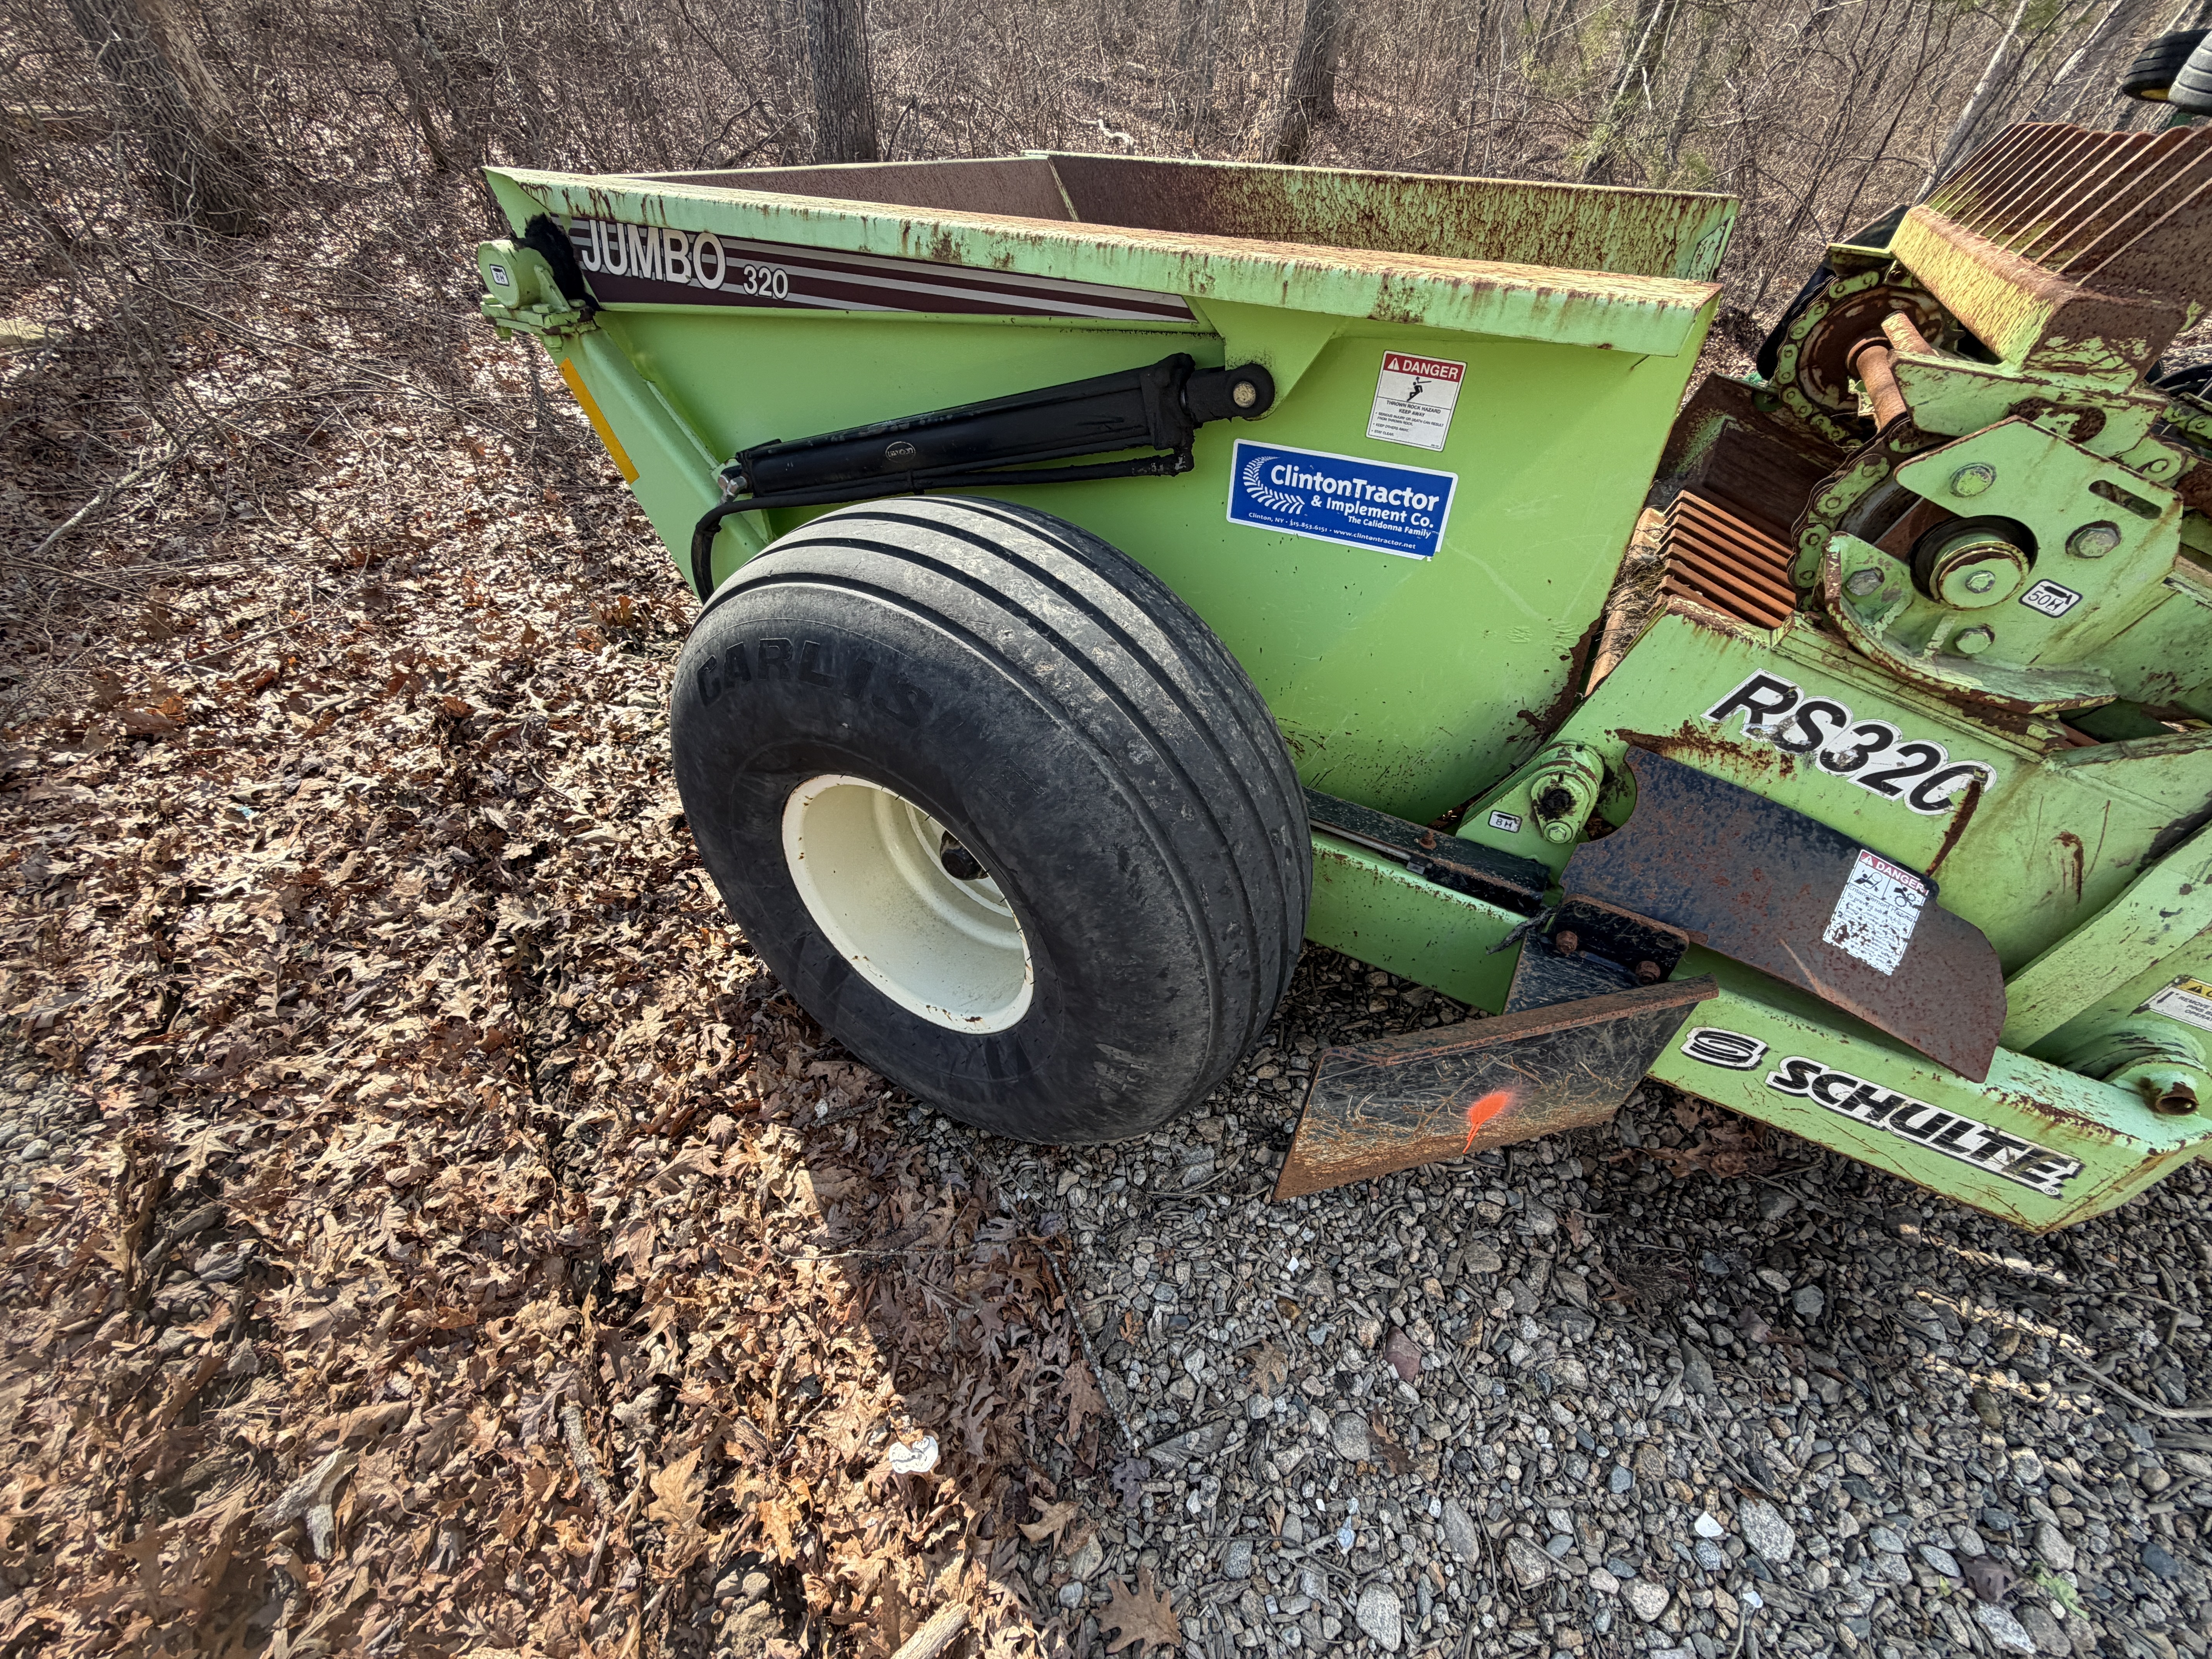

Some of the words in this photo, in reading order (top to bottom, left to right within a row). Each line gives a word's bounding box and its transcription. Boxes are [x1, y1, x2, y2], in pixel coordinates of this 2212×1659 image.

[581, 219, 726, 290] JUMBO
[743, 265, 788, 300] 320
[1402, 359, 1459, 380] DANGER
[1311, 495, 1322, 507] &
[1326, 497, 1407, 523] Implement
[1411, 513, 1434, 528] Co.
[1249, 512, 1273, 522] Clinton,
[1289, 520, 1328, 532] 315.853.6151
[1333, 529, 1416, 549] www.clintontractor.net
[1348, 516, 1361, 525] The
[1363, 519, 1402, 532] Calidonna
[1404, 526, 1431, 539] Family
[2028, 590, 2052, 605] 50
[1875, 861, 1925, 892] DANGER
[1854, 896, 1874, 910] prevnt
[1771, 1060, 2071, 1186] SCHULTE
